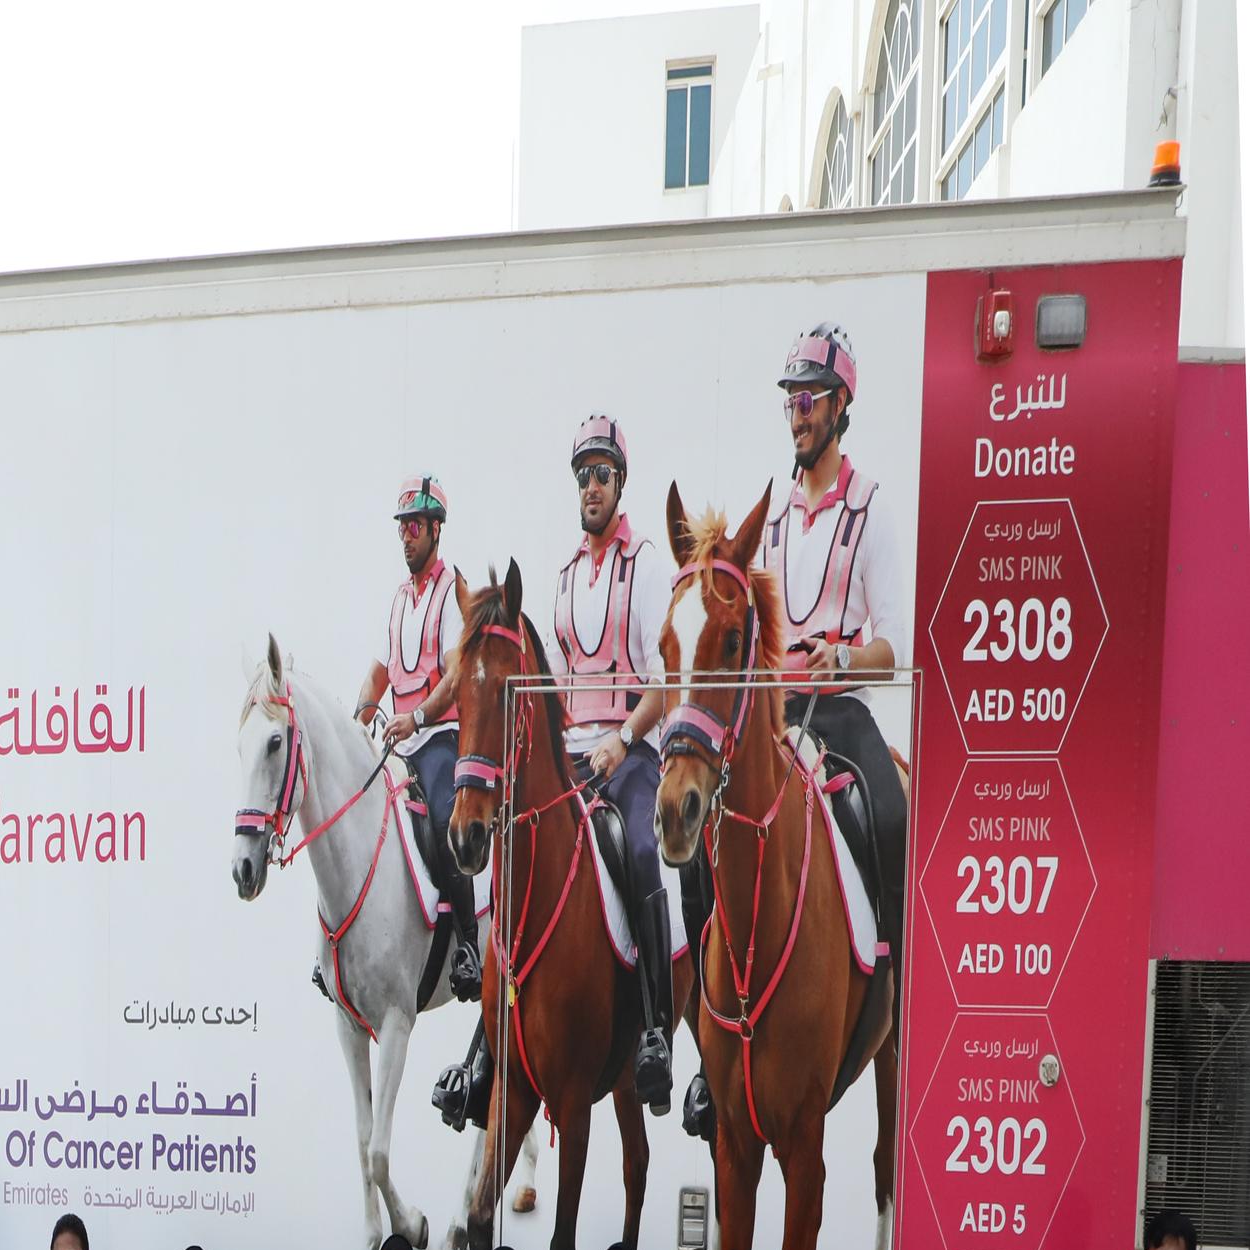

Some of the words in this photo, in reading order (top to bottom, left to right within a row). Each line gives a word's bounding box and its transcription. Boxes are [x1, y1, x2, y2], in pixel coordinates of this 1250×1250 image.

[990, 374, 1066, 421] للتبرع
[975, 437, 1074, 477] Donate
[985, 523, 1022, 541] وردي
[1027, 519, 1060, 540] ارسل
[979, 557, 1014, 582] SMS
[1021, 555, 1062, 580] PINK
[963, 597, 1072, 661] 2308
[964, 689, 1014, 721] AED
[1022, 688, 1065, 721] 500
[974, 783, 1011, 800] وردي
[1017, 780, 1049, 800] ارسل
[968, 816, 1003, 841] SMS
[1010, 817, 1050, 840] PINK
[956, 856, 1058, 914] 2307
[957, 944, 1004, 973] AED
[1015, 944, 1052, 974] 100
[124, 1001, 195, 1030] مبادرات
[202, 1003, 257, 1031] إحدى
[964, 1040, 1002, 1058] وردي
[1006, 1039, 1038, 1059] ارسل
[35, 1081, 127, 1121] مرضى
[136, 1073, 256, 1117] أصدقاء
[958, 1078, 993, 1102] SMS
[999, 1080, 1040, 1104] PINK
[6, 1130, 35, 1167] Of
[44, 1131, 143, 1170] Cancer
[153, 1134, 256, 1174] Patients
[946, 1116, 1047, 1174] 2302
[4, 1182, 69, 1205] Emirates
[84, 1186, 141, 1209] المتحدة
[146, 1186, 196, 1215] العربية
[202, 1192, 254, 1217] الإمارات
[960, 1203, 1006, 1232] AED
[1013, 1205, 1025, 1234] 5
